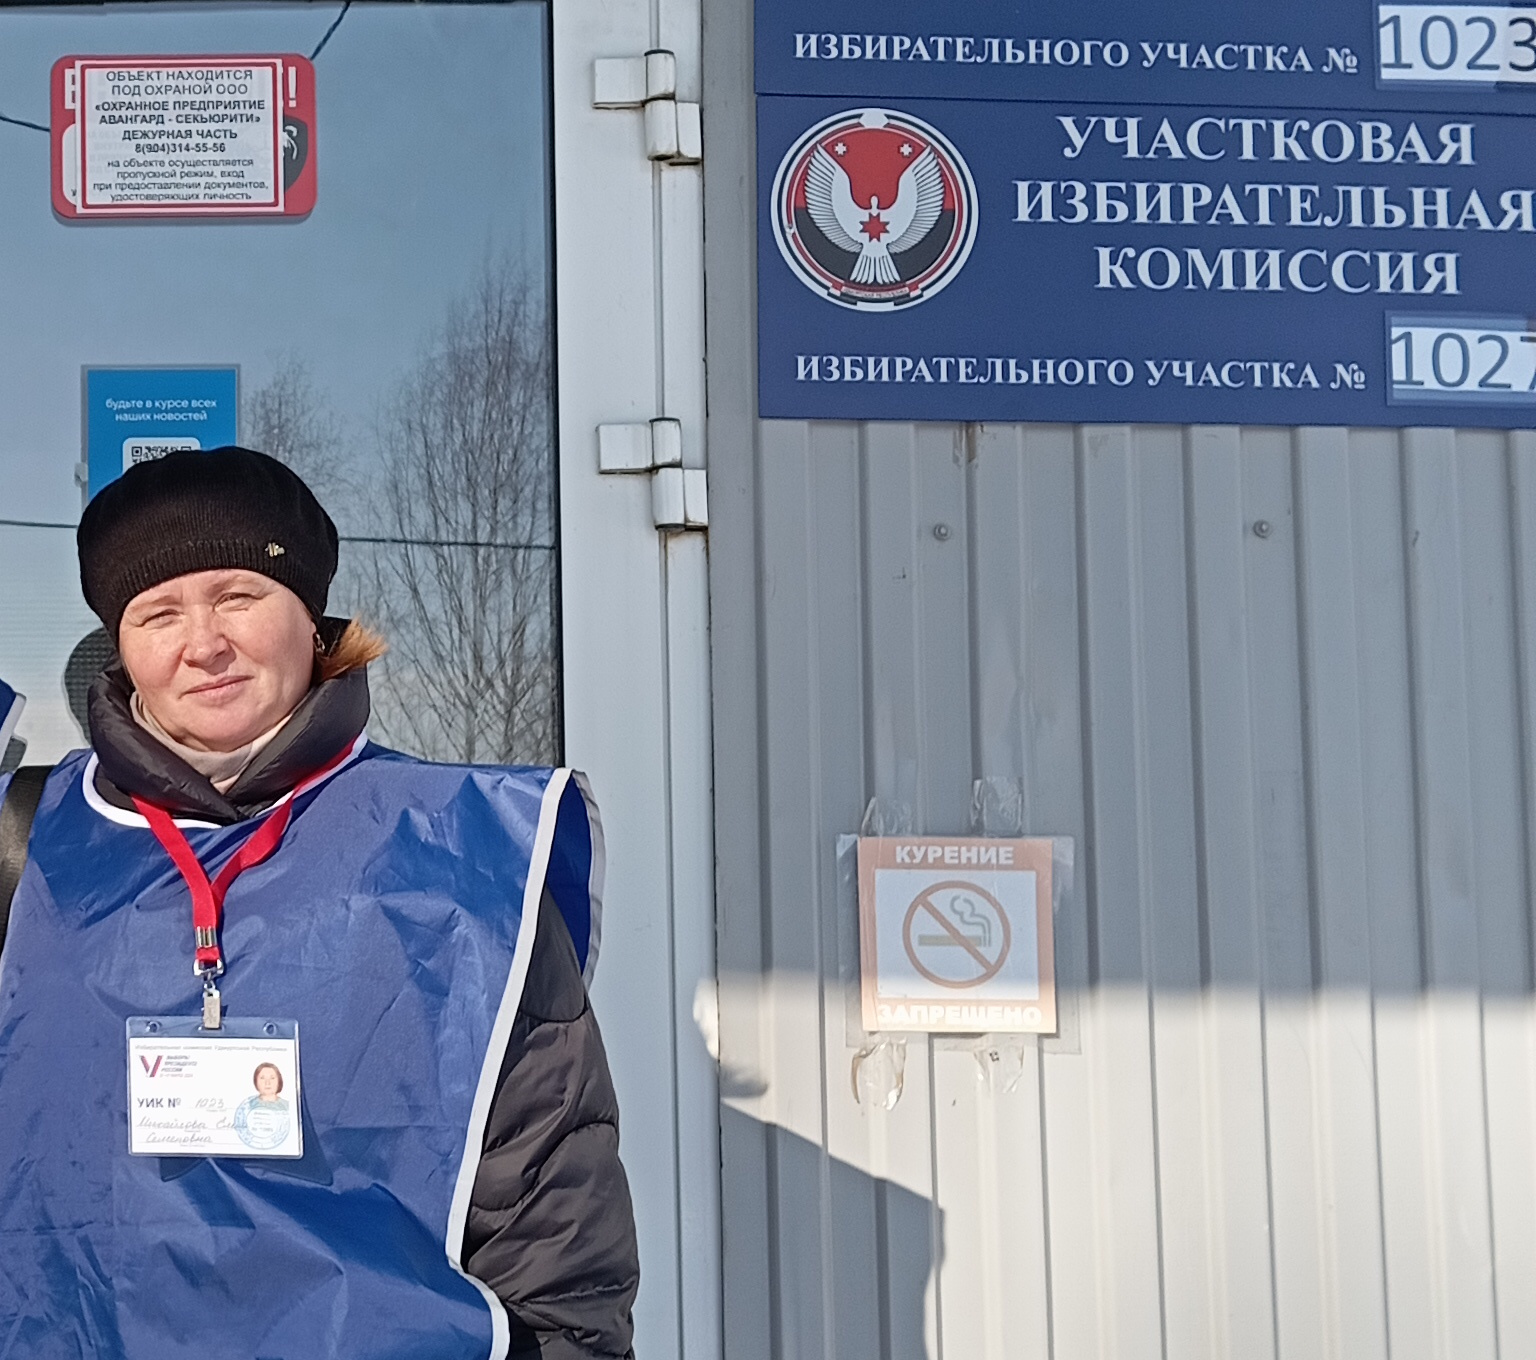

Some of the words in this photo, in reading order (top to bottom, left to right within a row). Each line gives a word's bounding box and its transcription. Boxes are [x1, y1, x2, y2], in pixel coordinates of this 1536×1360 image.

[796, 34, 1128, 66] ИЗБИРАТЕЛЬНОГО
[1140, 43, 1313, 71] УЧАСТКА
[1322, 48, 1357, 72] №
[1380, 15, 1536, 72] 1023
[106, 71, 162, 81] ОБЪЕКТ
[166, 70, 252, 82] НАХОДИТСЯ
[112, 85, 141, 97] ПОД
[144, 80, 212, 95] ОХРАНОЙ
[216, 84, 248, 94] ООО
[173, 100, 265, 112] ПРЕДПРИЯТИЕ
[99, 114, 164, 125] АВАНГАРД
[122, 130, 192, 141] ДЕЖУРНАЯ
[196, 129, 237, 139] ЧАСТЬ
[1057, 117, 1475, 164] УЧАСТКОВАЯ
[1012, 180, 1536, 233] ИЗБИРАТЕЛЬНАЯ
[1094, 247, 1459, 294] КОМИССИЯ
[797, 356, 1133, 385] ИЗБИРАТЕЛЬНОГО
[1145, 361, 1320, 388] УЧАСТКА
[1330, 364, 1365, 389] №
[106, 398, 143, 410] будьте
[146, 400, 152, 408] в
[155, 400, 188, 410] курсе
[192, 400, 216, 408] всех
[154, 410, 207, 420] новостей
[896, 846, 1014, 865] КУРЕНИЕ
[877, 1005, 1042, 1026] ЗАПРЕЩЕНО
[138, 1098, 163, 1108] УИК
